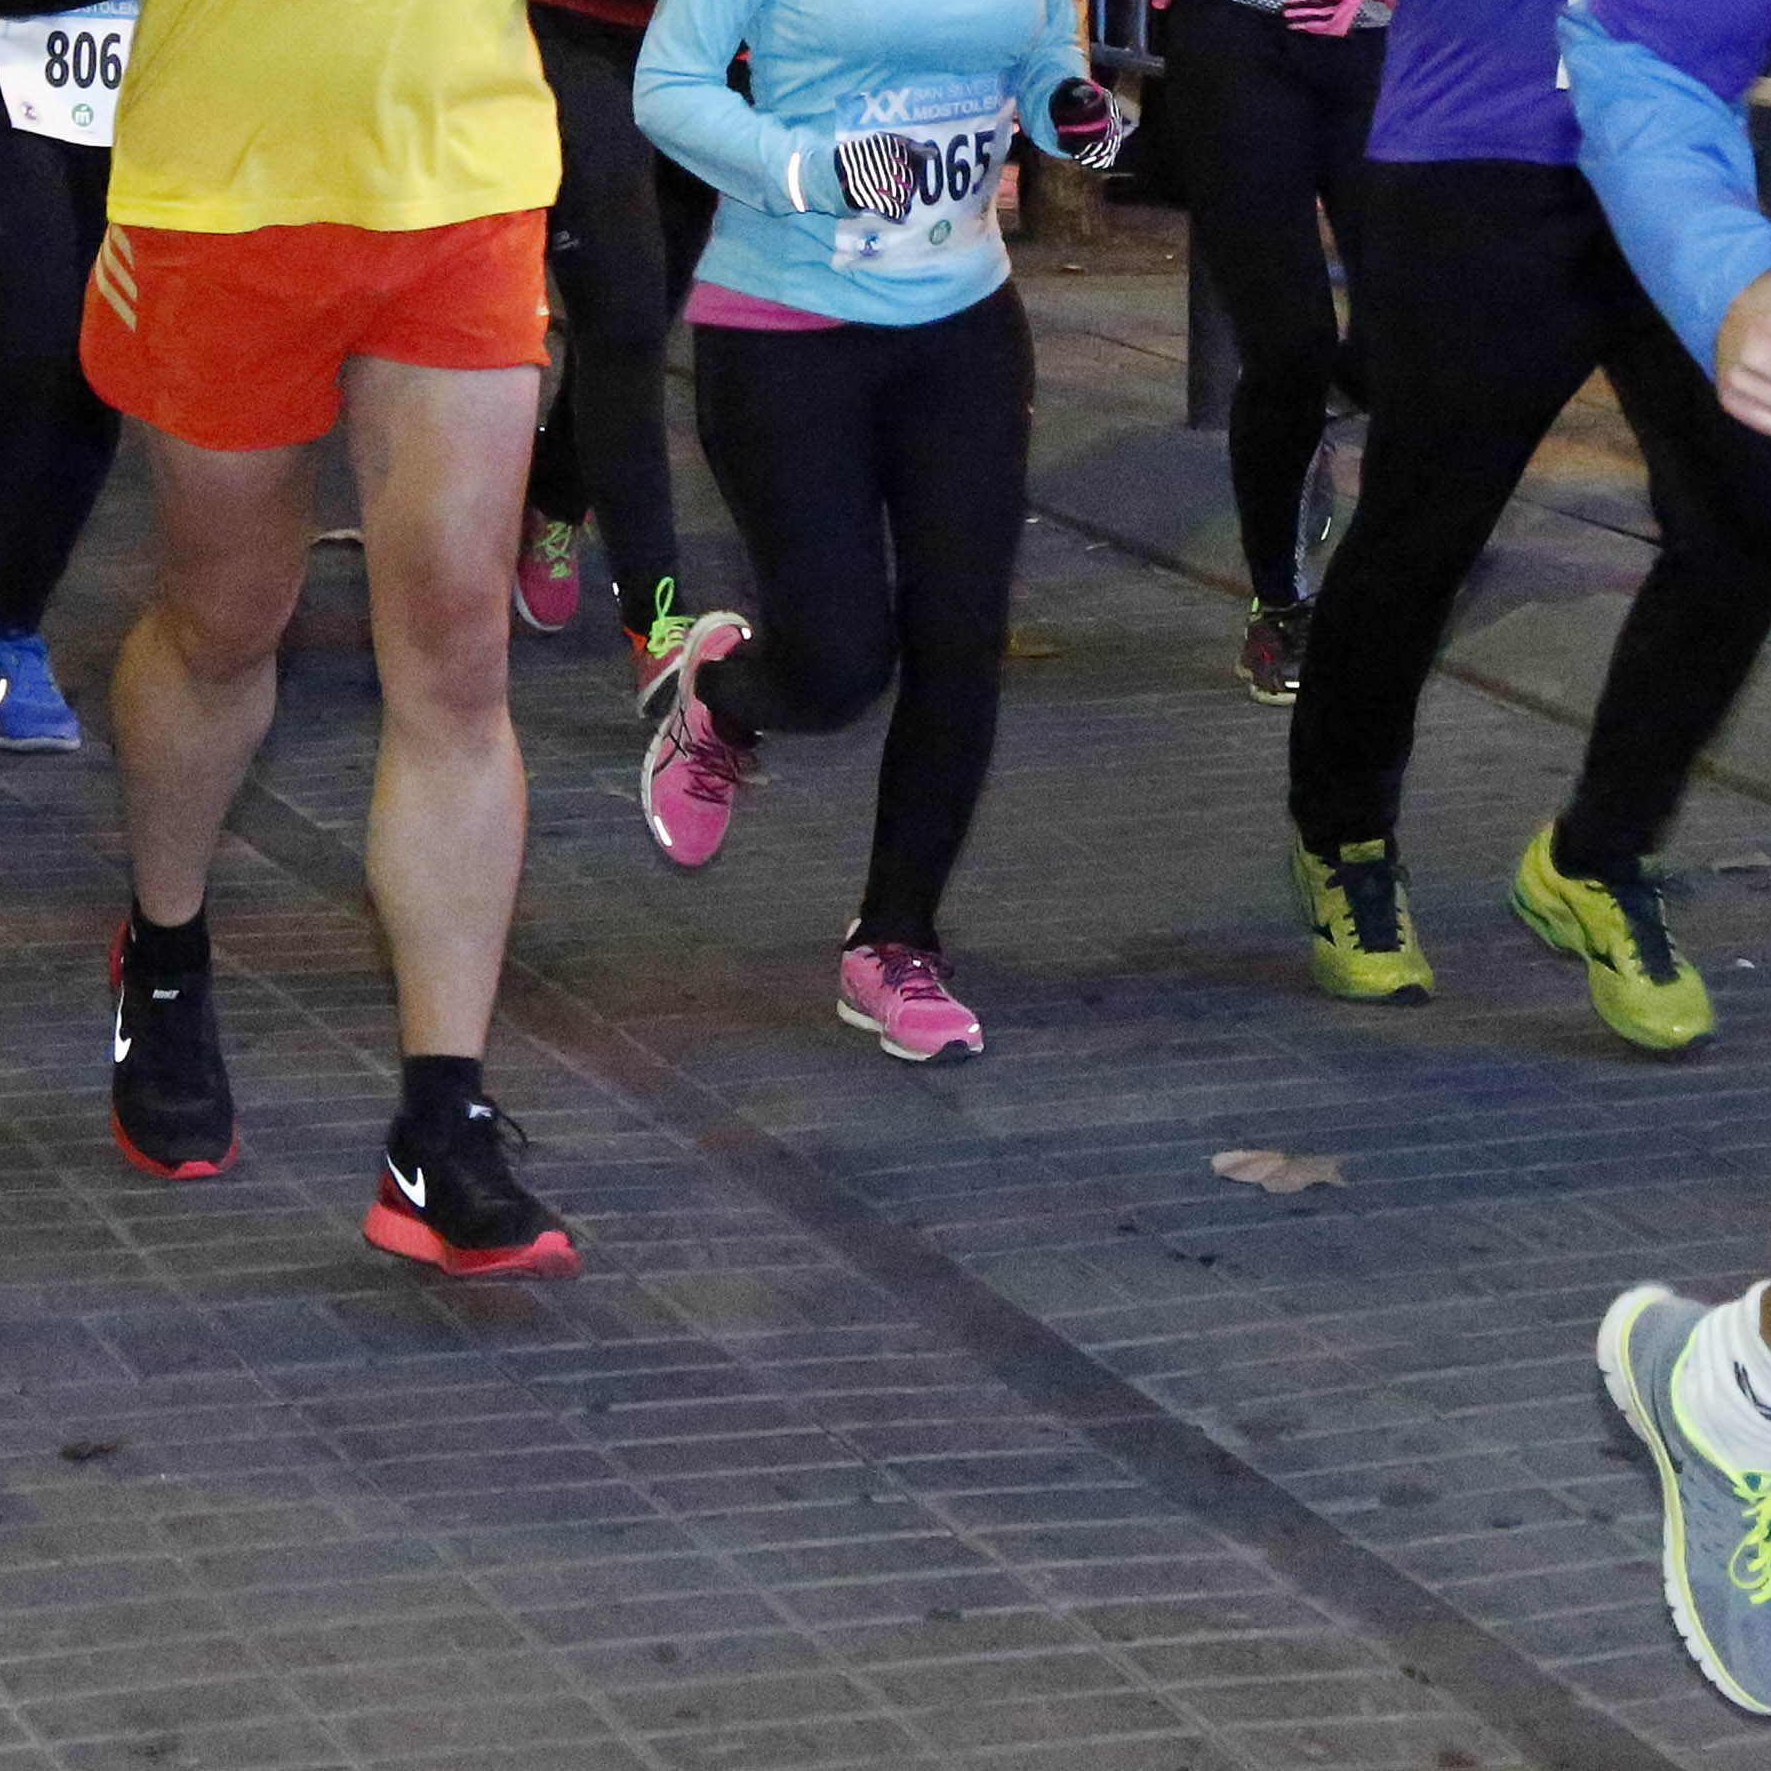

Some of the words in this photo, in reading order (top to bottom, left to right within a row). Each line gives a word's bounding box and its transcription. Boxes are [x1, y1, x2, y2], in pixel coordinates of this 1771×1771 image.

[44, 30, 123, 90] 806
[862, 89, 911, 122] XX
[913, 85, 945, 104] SAN
[917, 130, 998, 206] 065
